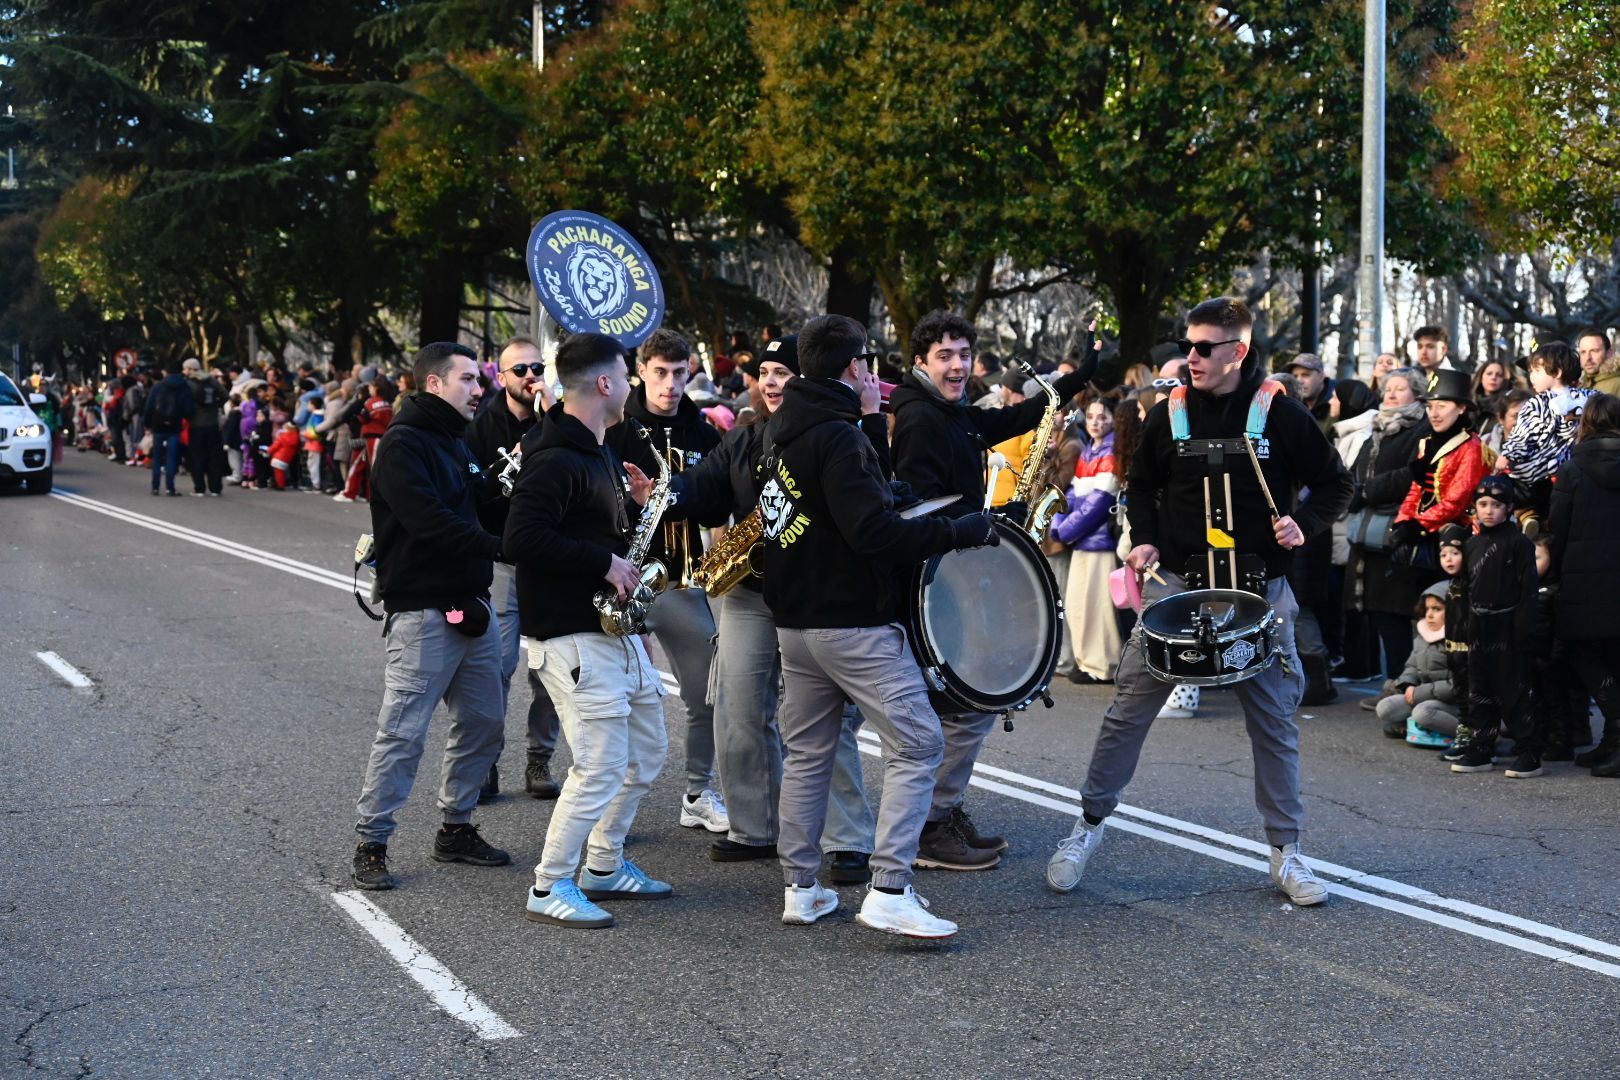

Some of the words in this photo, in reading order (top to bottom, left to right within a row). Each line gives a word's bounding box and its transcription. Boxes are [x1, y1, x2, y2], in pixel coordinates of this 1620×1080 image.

[547, 226, 650, 291] PACHARANGA
[543, 267, 575, 316] León
[599, 302, 648, 335] SOUND
[778, 459, 802, 499] NGA
[780, 513, 811, 548] SOUN
